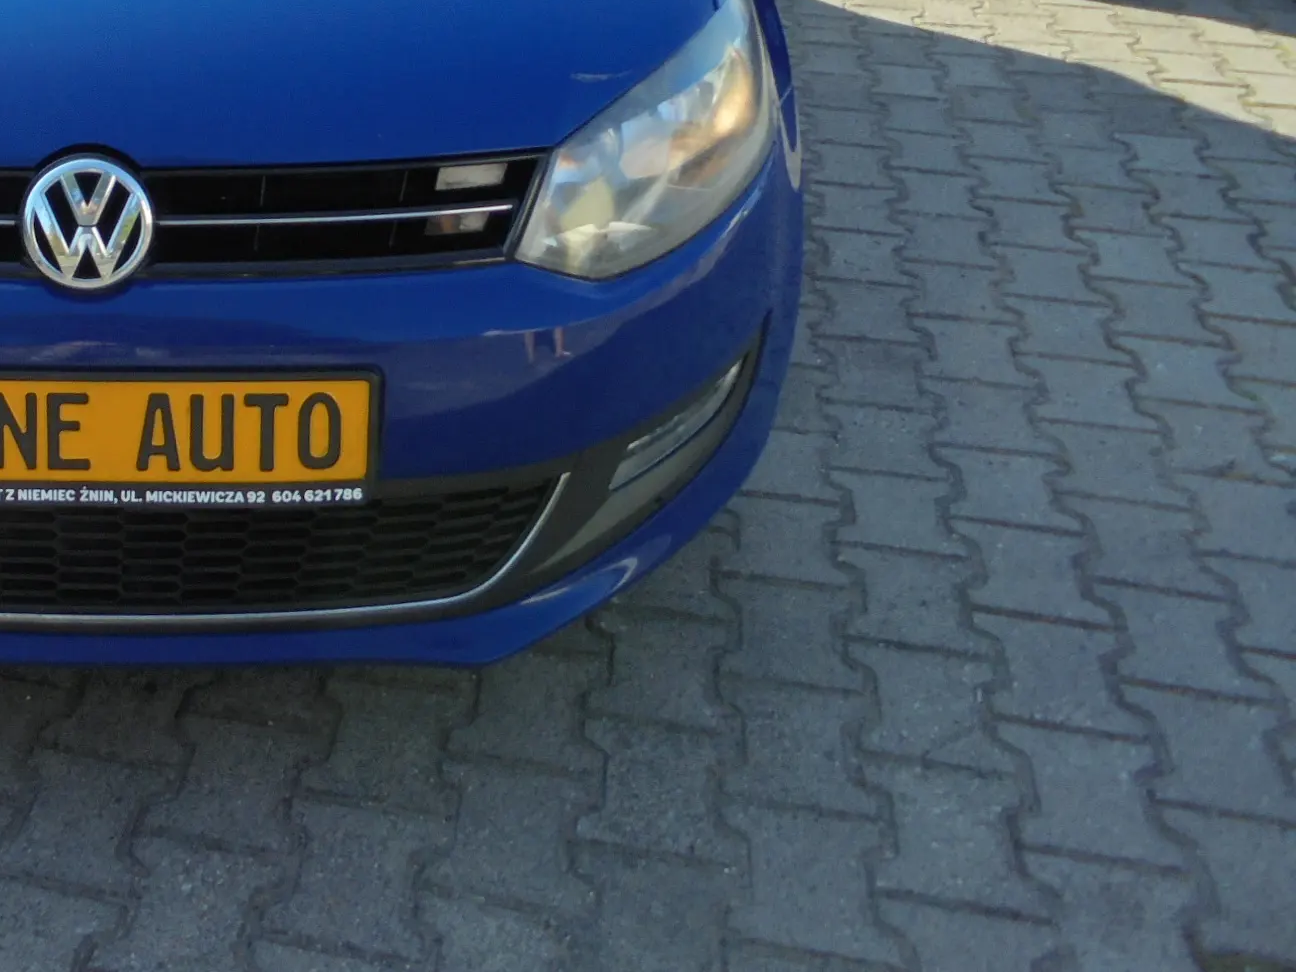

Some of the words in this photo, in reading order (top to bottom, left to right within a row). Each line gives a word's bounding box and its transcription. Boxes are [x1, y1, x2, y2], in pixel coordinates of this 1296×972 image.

[135, 392, 342, 471] AUTO
[5, 488, 15, 501] Z
[17, 489, 76, 502] NIEMIEC
[121, 490, 143, 503] UL.
[146, 490, 244, 504] MICKIEWICZA
[247, 491, 265, 503] 92
[272, 490, 301, 503] 604
[304, 490, 331, 503] 621
[333, 488, 363, 501] 786
